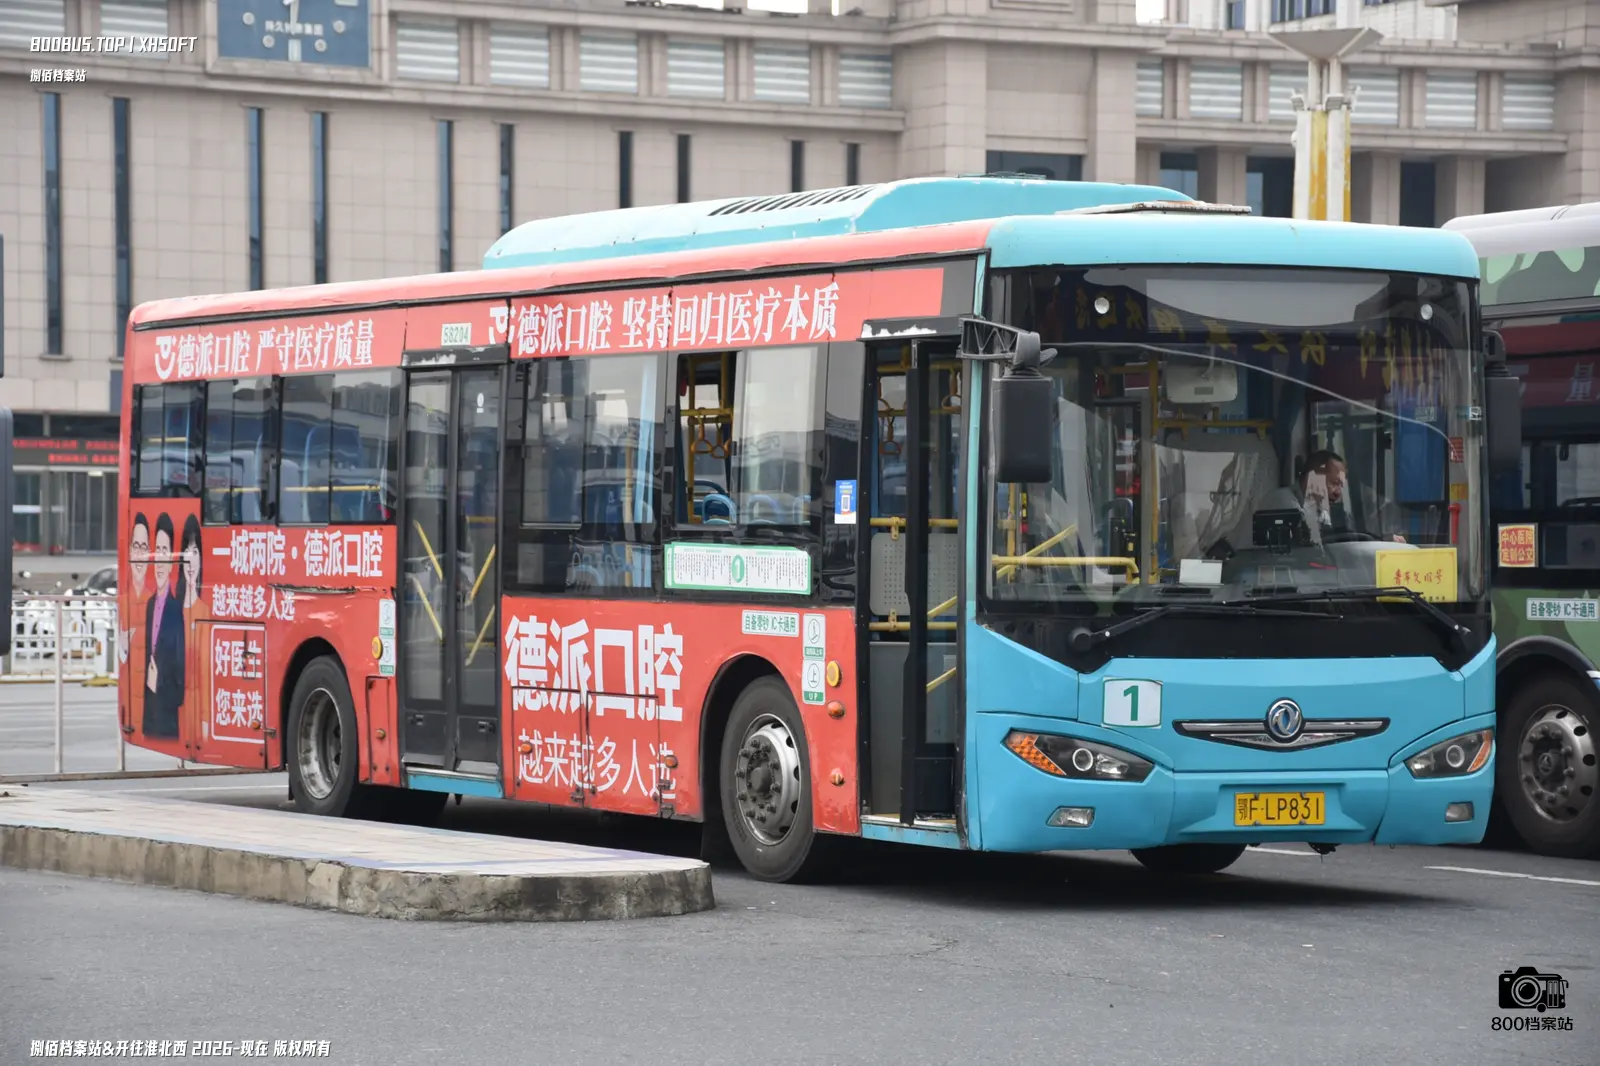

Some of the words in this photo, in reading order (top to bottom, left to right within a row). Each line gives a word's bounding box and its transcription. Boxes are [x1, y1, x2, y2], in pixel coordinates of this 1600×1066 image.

[517, 299, 613, 356] 德派口腔
[619, 281, 840, 349] 坚持回归医疗本质
[177, 331, 251, 379] 德派口腔
[255, 318, 375, 371] 严守医疗质量
[1501, 529, 1533, 545] 中心医院
[212, 584, 296, 621] 越来越多人选
[215, 638, 263, 679] 好医生
[504, 615, 684, 722] 德派口腔
[215, 688, 263, 727] 您来选
[1122, 684, 1139, 722] 1
[518, 728, 677, 800] 越来越多人选
